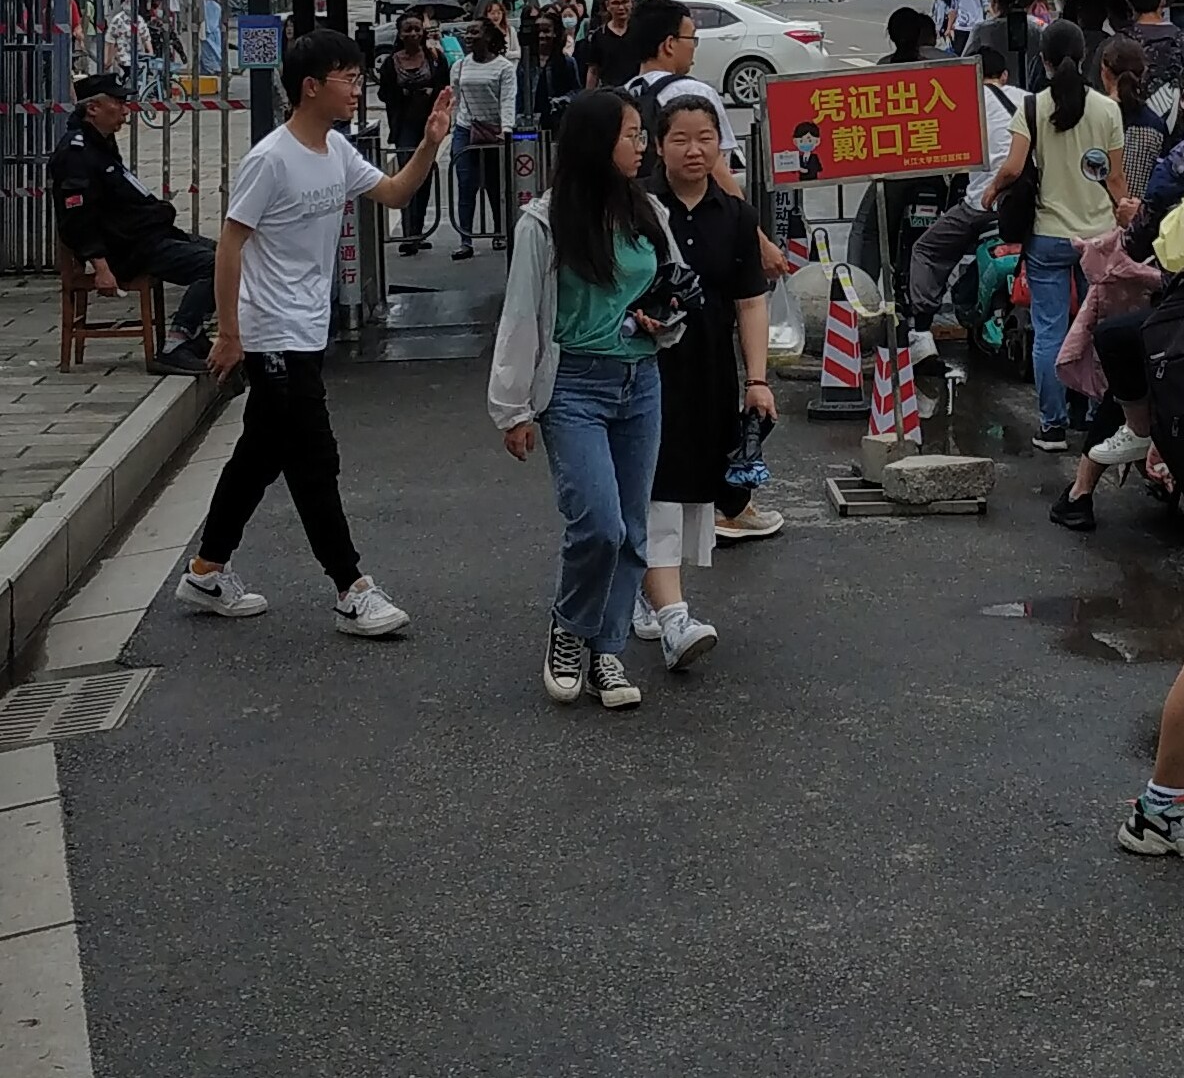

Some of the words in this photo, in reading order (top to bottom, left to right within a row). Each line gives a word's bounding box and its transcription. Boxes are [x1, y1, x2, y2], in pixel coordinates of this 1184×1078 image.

[810, 78, 957, 125] 凭证出入
[831, 119, 942, 162] 戴口罩
